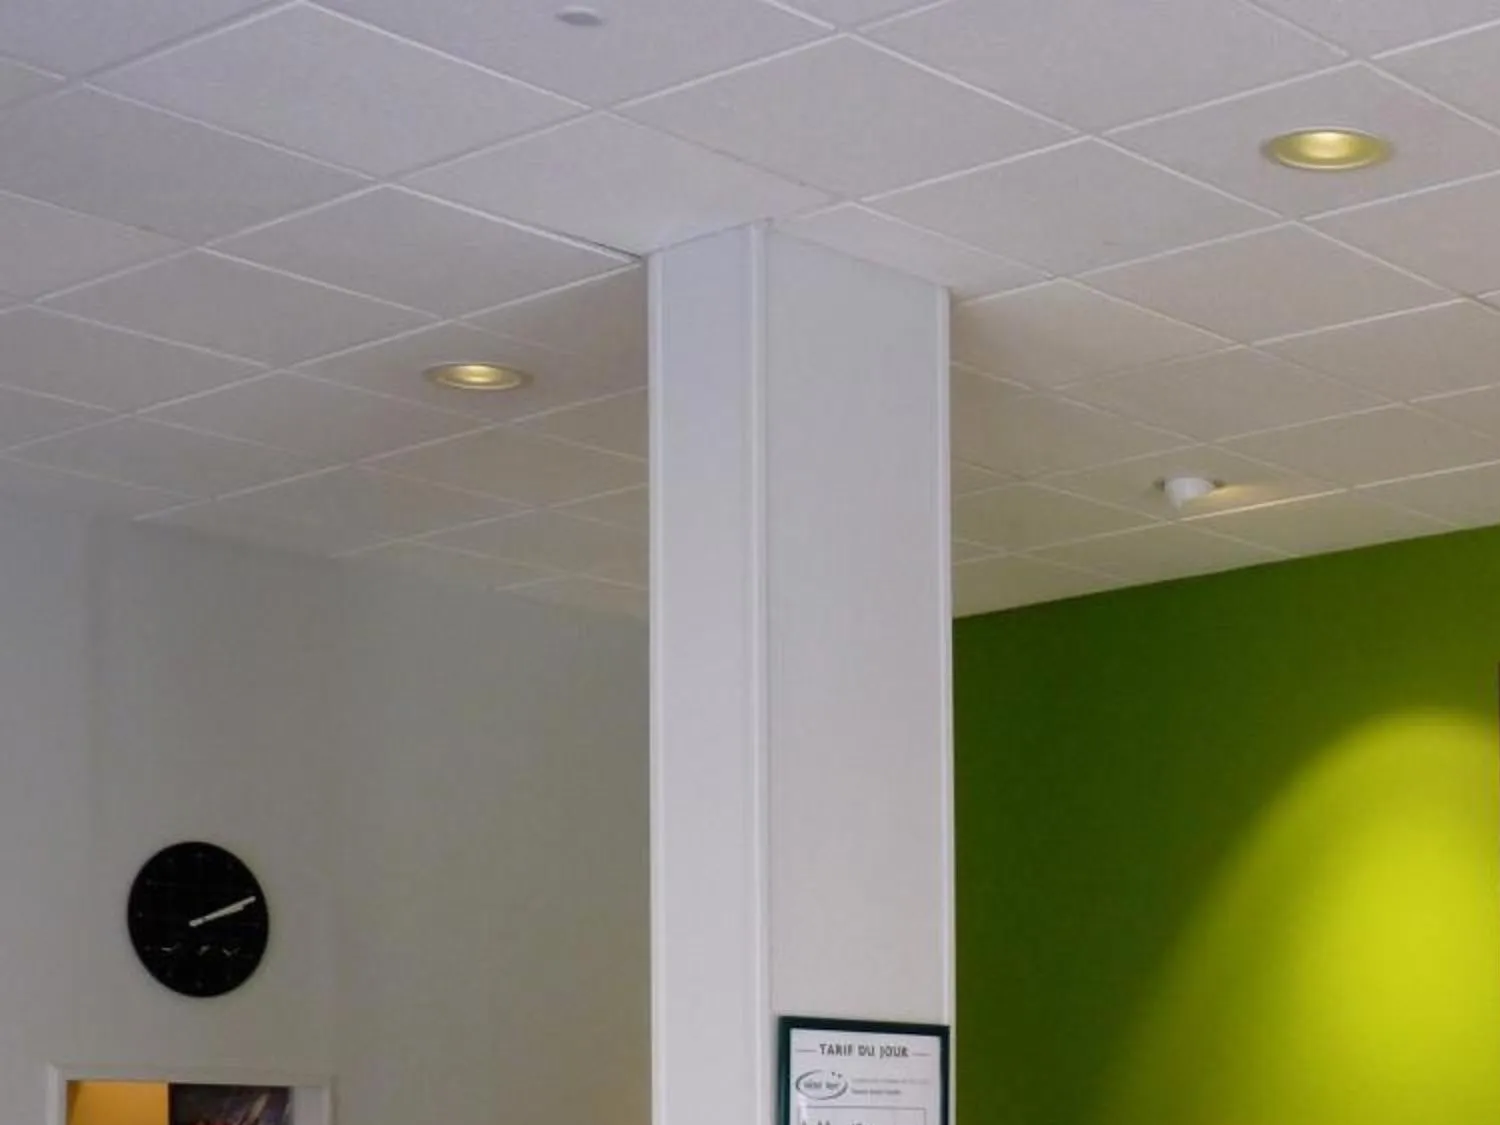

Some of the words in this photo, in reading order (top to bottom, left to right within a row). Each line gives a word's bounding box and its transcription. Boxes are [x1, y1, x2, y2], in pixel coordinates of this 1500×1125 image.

[819, 1043, 852, 1056] TARIF
[858, 1044, 875, 1057] DU
[879, 1045, 909, 1059] JOUR
